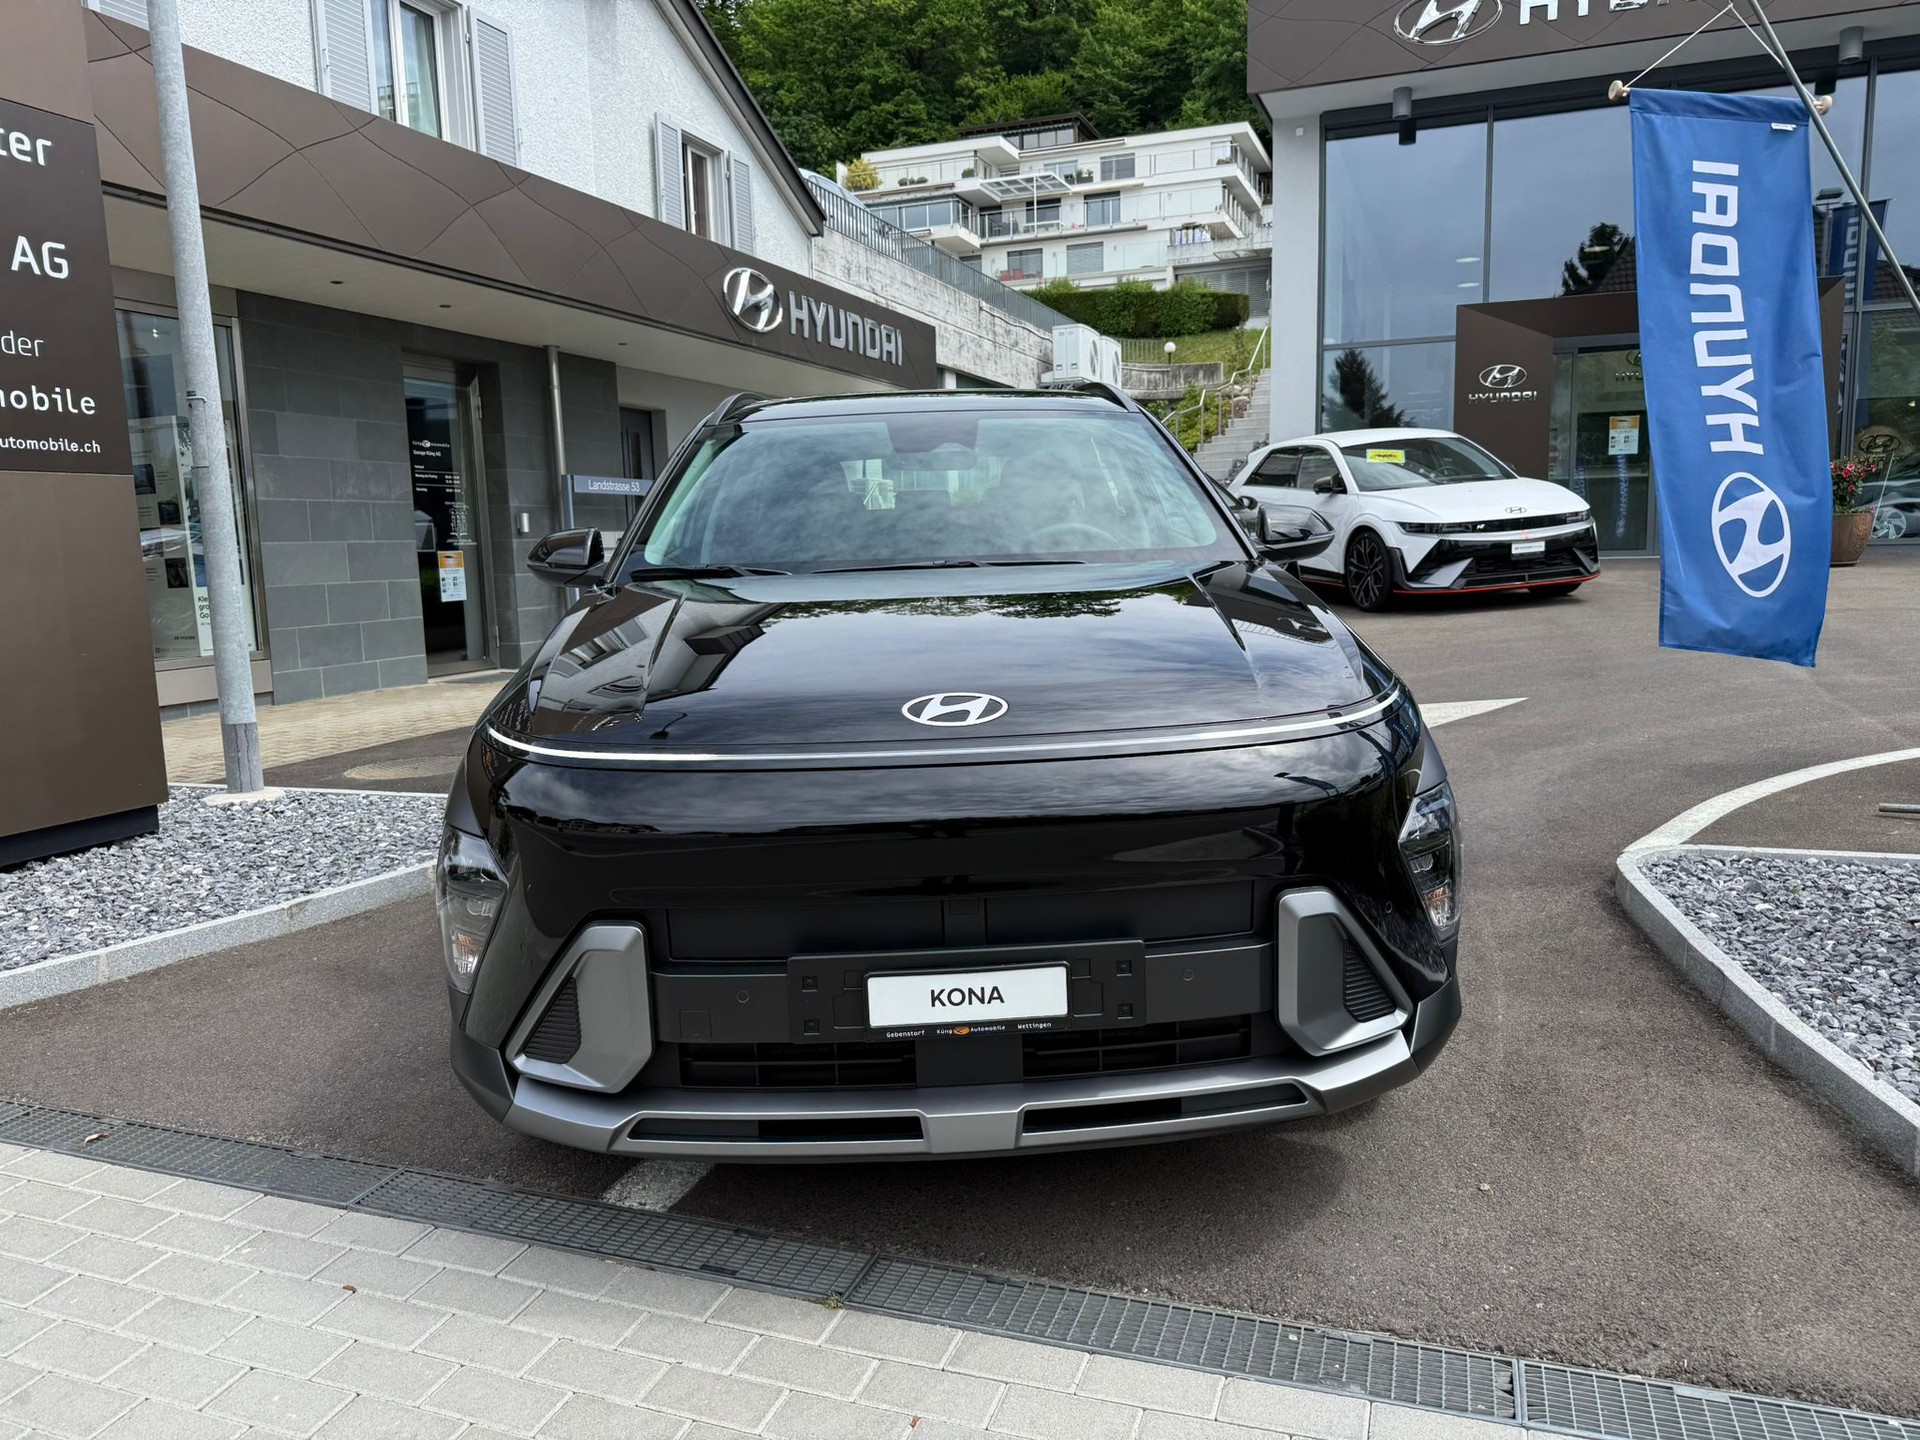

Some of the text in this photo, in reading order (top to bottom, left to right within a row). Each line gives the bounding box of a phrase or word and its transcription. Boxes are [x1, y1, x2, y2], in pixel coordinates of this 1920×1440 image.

[11, 235, 69, 279] AG
[1690, 160, 1764, 455] HYUNDAI
[788, 290, 903, 367] HYUNDAI
[0, 329, 44, 357] der
[1468, 390, 1538, 404] HYUNDAI
[588, 479, 640, 492] Landstrasse 53
[930, 985, 1005, 1008] KONA
[886, 1029, 925, 1038] Gebenstorf
[1017, 1022, 1052, 1030] Wettingen
